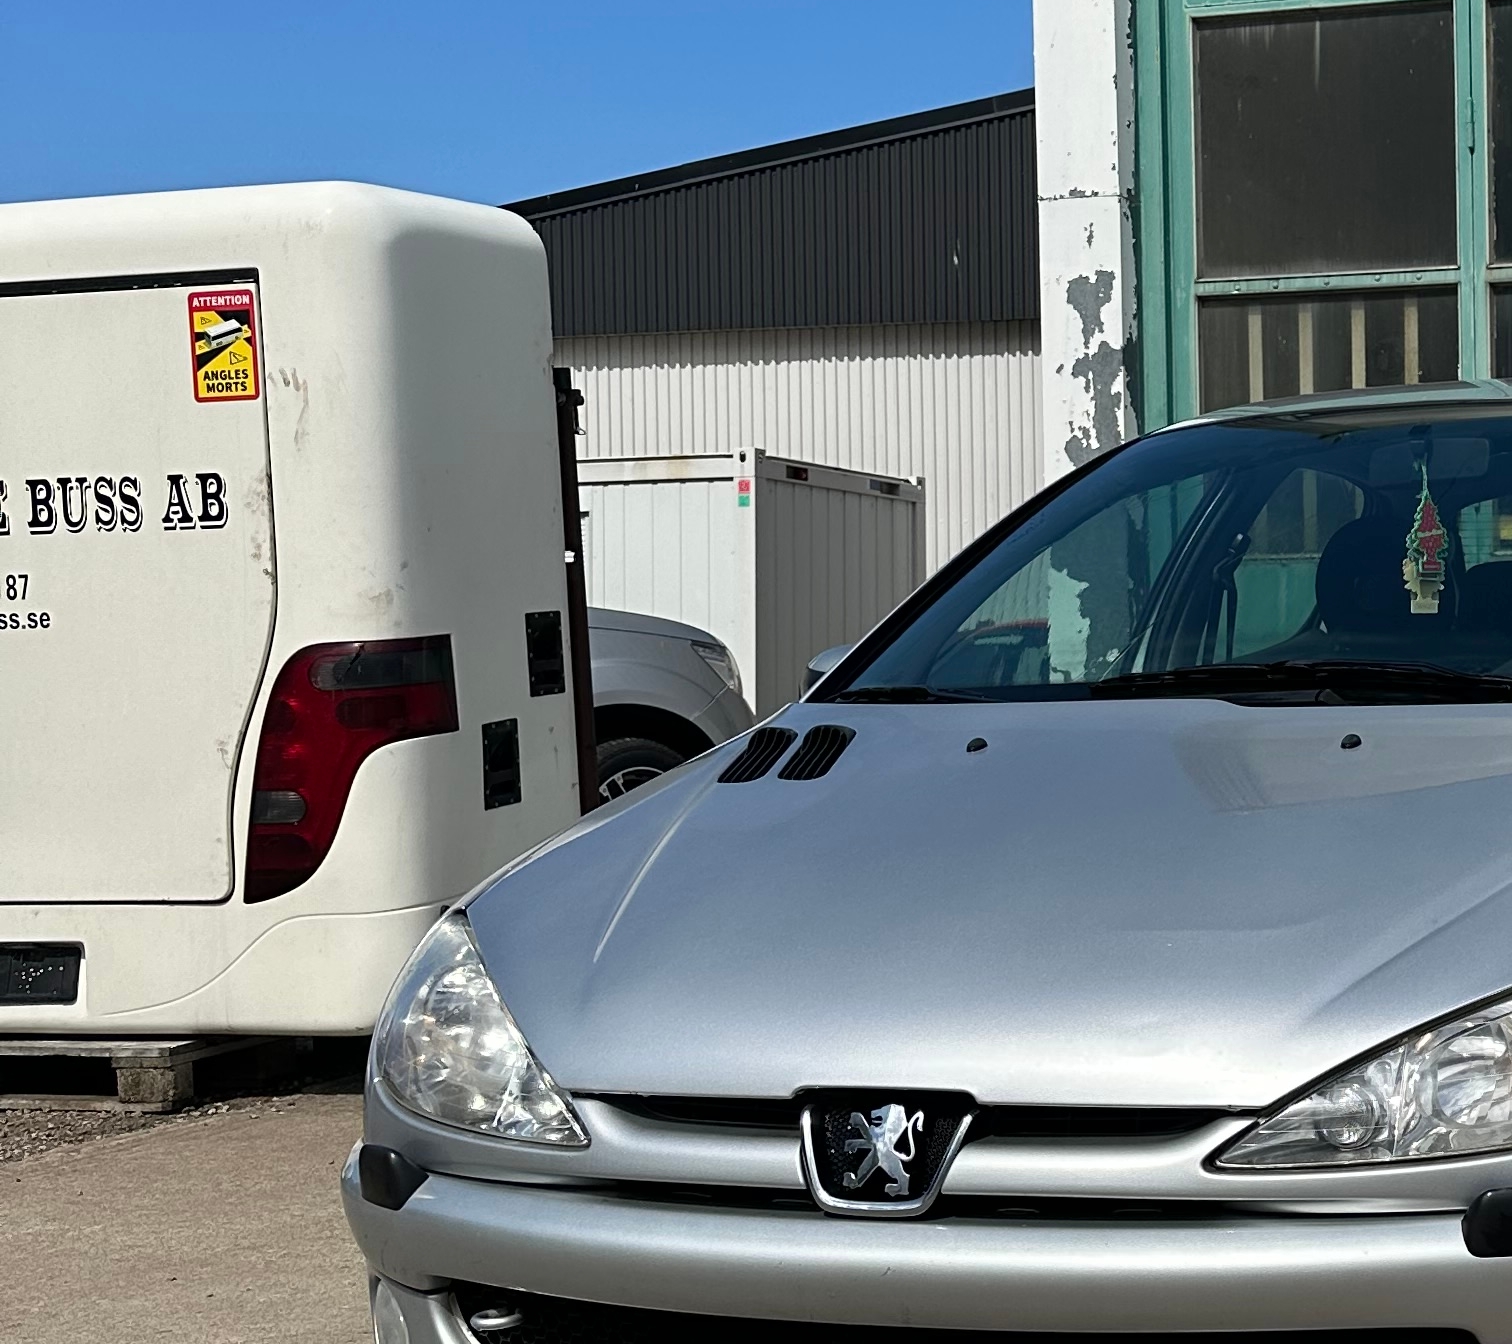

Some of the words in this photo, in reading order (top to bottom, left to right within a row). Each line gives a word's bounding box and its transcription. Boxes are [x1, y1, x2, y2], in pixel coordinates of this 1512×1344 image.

[192, 295, 250, 308] ATTENTION
[203, 369, 249, 381] ANGLES
[206, 381, 248, 394] MORTS
[25, 476, 143, 535] BUSS
[162, 472, 229, 531] AB
[6, 574, 28, 602] 87
